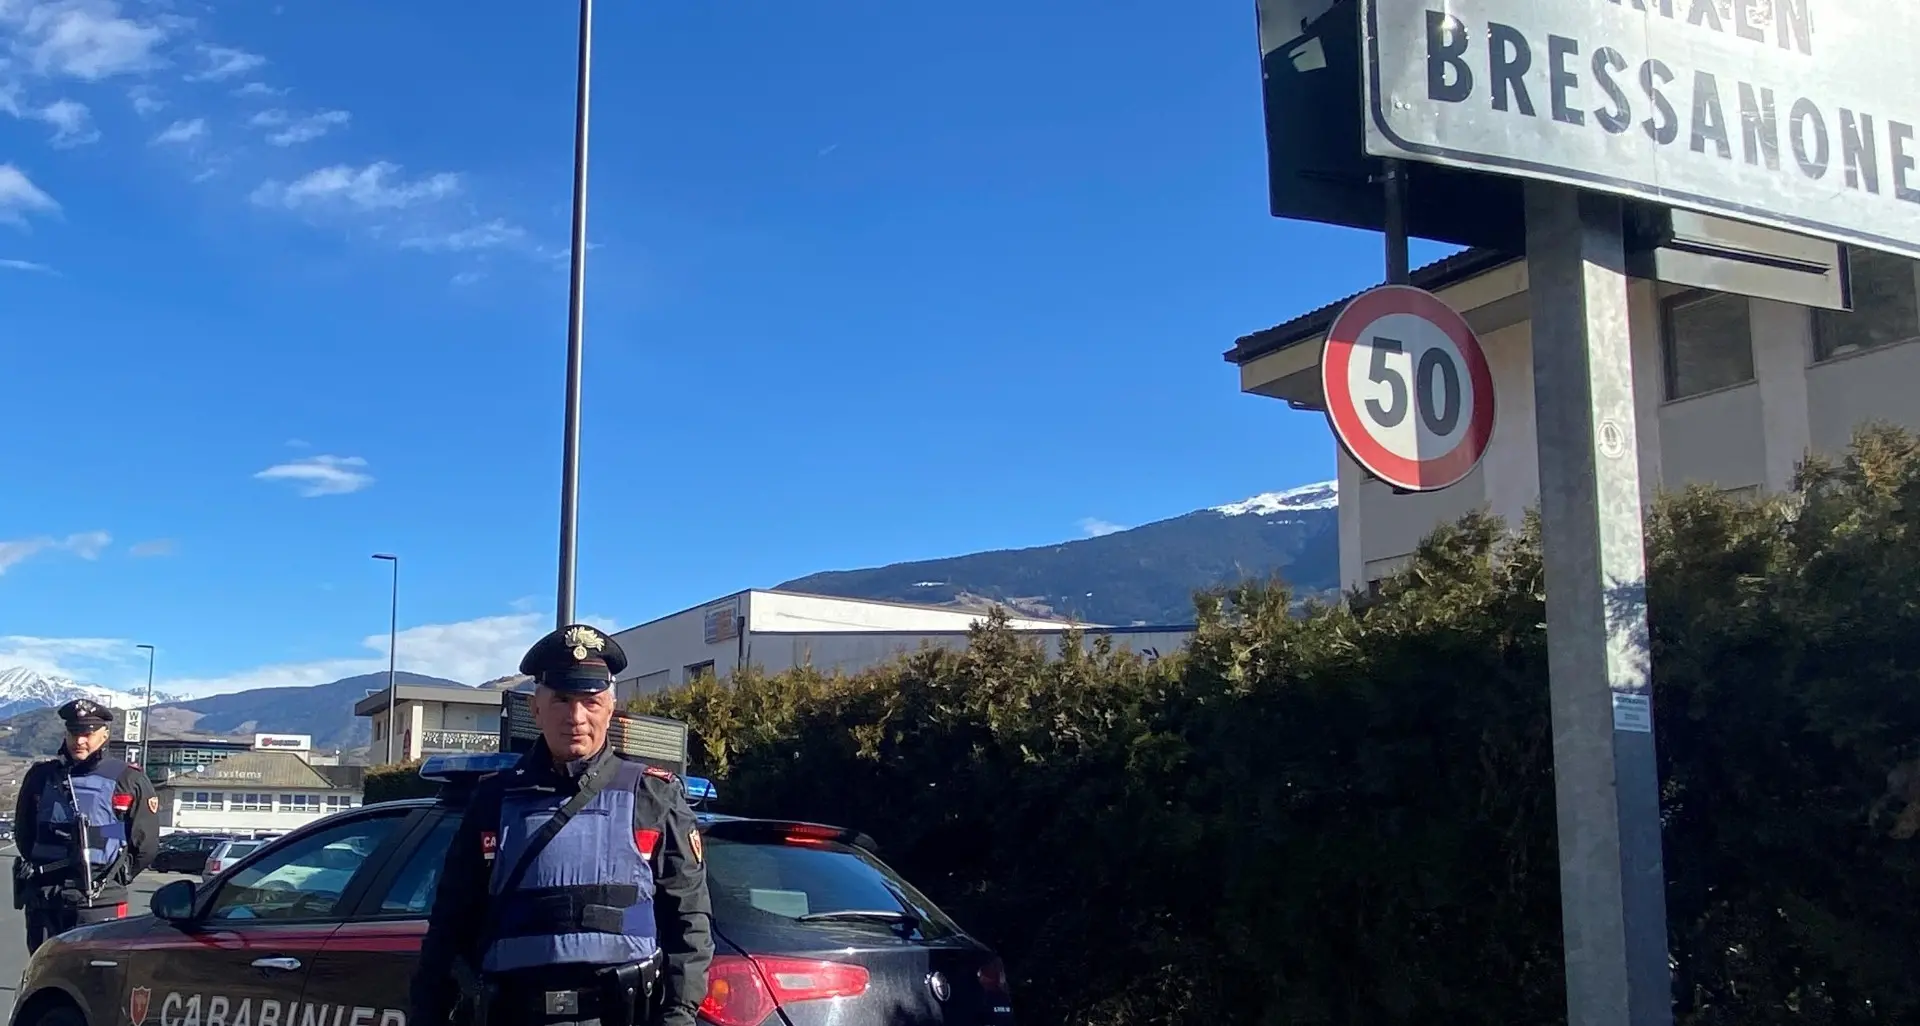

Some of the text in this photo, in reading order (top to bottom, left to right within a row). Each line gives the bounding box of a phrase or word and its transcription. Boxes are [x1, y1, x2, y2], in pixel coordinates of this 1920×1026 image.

[1426, 10, 1920, 202] BRESSANONE
[1364, 336, 1460, 436] 50
[218, 769, 262, 779] systems
